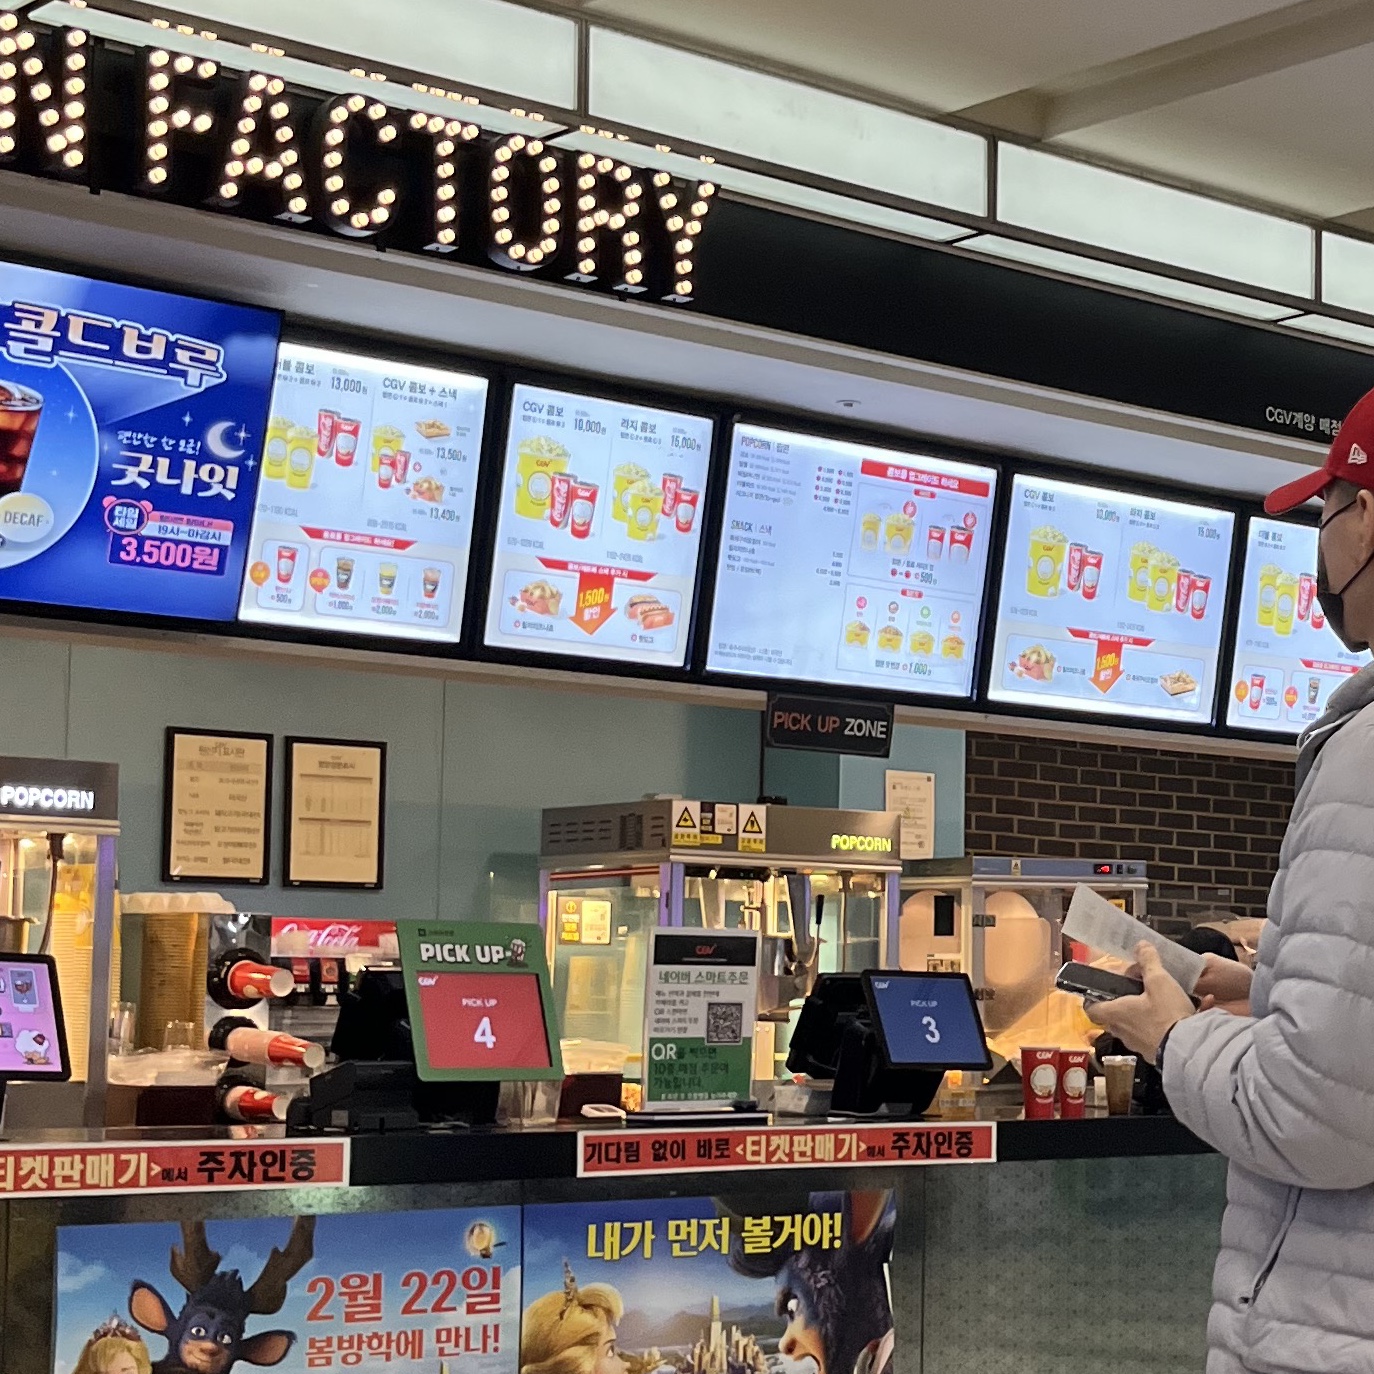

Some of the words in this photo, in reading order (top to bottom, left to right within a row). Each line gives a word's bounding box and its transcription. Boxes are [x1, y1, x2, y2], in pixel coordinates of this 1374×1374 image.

[140, 43, 718, 302] FACTORY
[4, 301, 225, 388] 콜드브루
[383, 377, 406, 391] CGV
[523, 401, 544, 414] CGV
[111, 450, 239, 501] 굿나잇
[3, 509, 45, 527] DECAF
[773, 711, 812, 732] PICK
[817, 714, 841, 733] UP
[844, 717, 888, 739] ZONE
[0, 785, 95, 811] POPCORN
[831, 834, 892, 852] POPCORN
[420, 943, 471, 963] PICK
[475, 944, 505, 964] UP
[659, 971, 691, 984] 네이버
[461, 998, 484, 1007] PICK
[485, 998, 498, 1008] UP
[473, 1016, 497, 1049] 4
[922, 1016, 941, 1044] 3
[585, 1141, 641, 1165] 기다림
[651, 1140, 686, 1162] 없이
[696, 1137, 731, 1160] 바로
[587, 1220, 656, 1261] 내가
[668, 1218, 730, 1258] 먼저
[741, 1212, 843, 1255] 볼거야!
[305, 1271, 384, 1323] 2월
[400, 1264, 503, 1317] 22일
[304, 1329, 423, 1368] 봄방학에
[435, 1323, 501, 1358] 만나!
